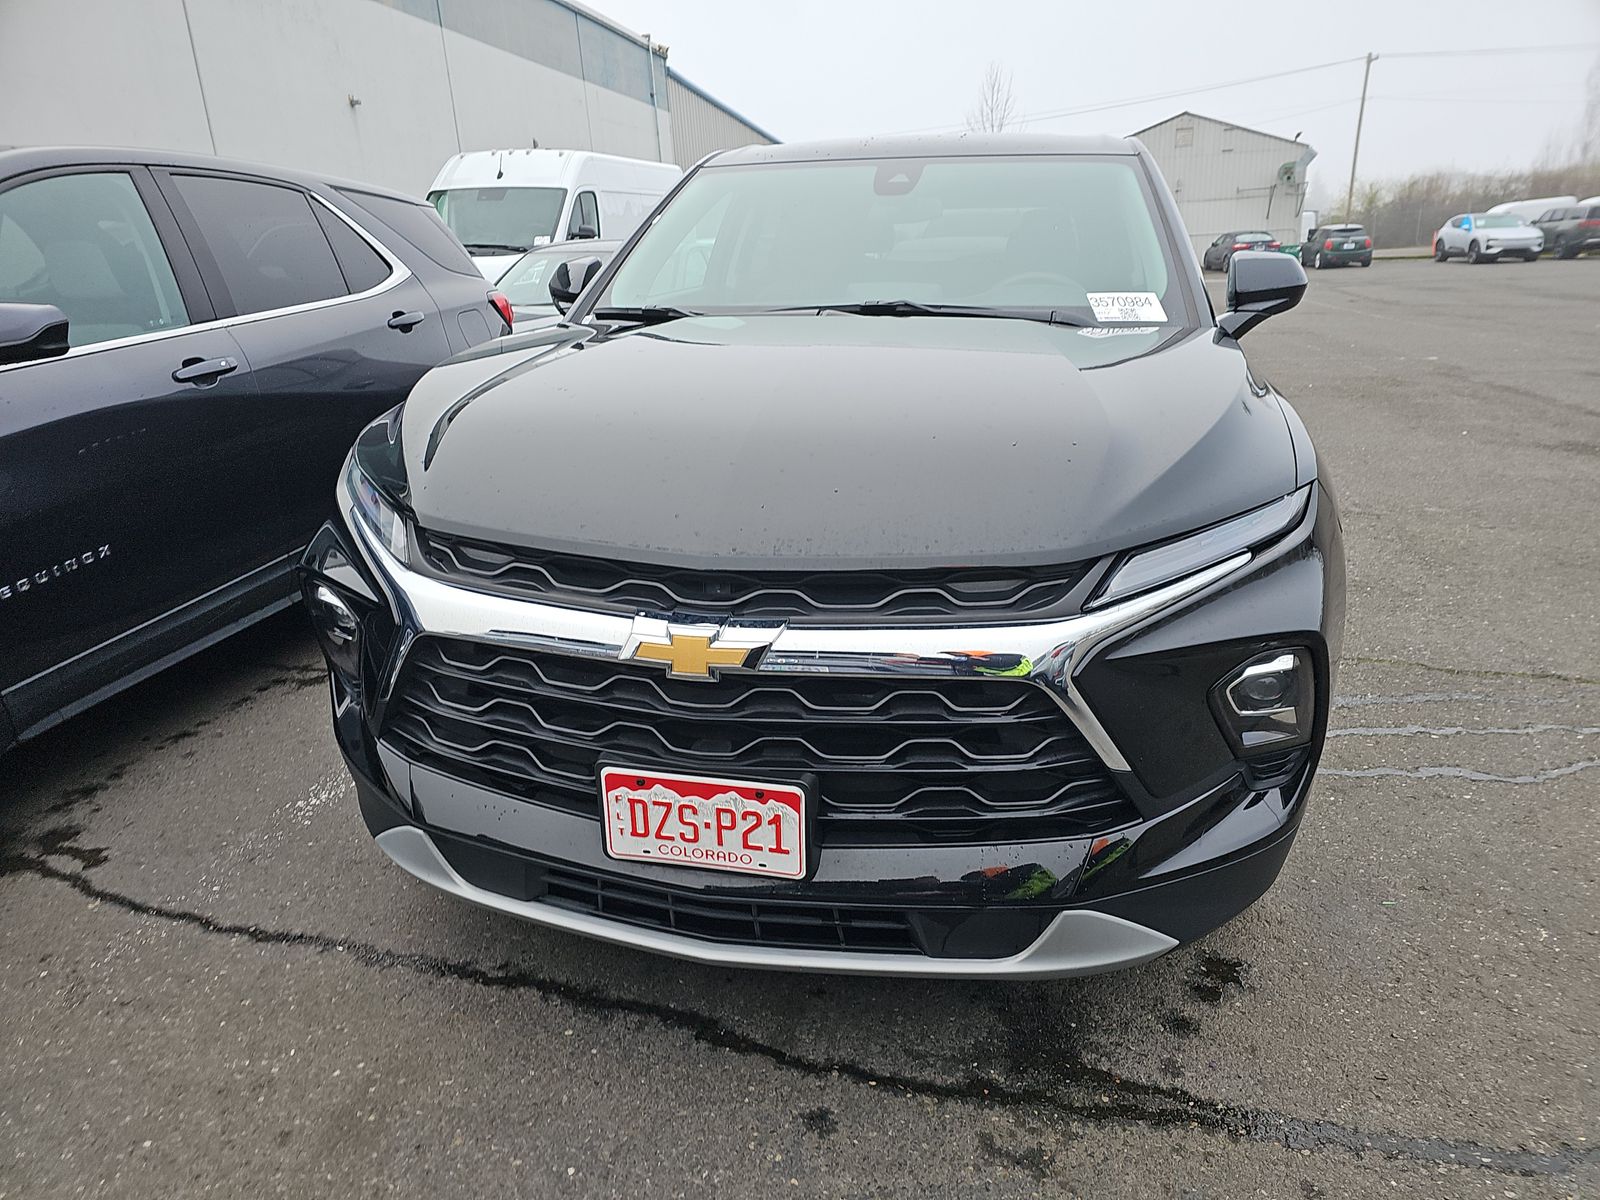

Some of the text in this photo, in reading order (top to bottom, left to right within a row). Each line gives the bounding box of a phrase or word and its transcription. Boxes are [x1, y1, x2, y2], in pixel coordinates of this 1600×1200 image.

[1089, 296, 1152, 308] 3570984
[0, 544, 111, 600] EQUINOX
[657, 844, 753, 865] COLORADO
